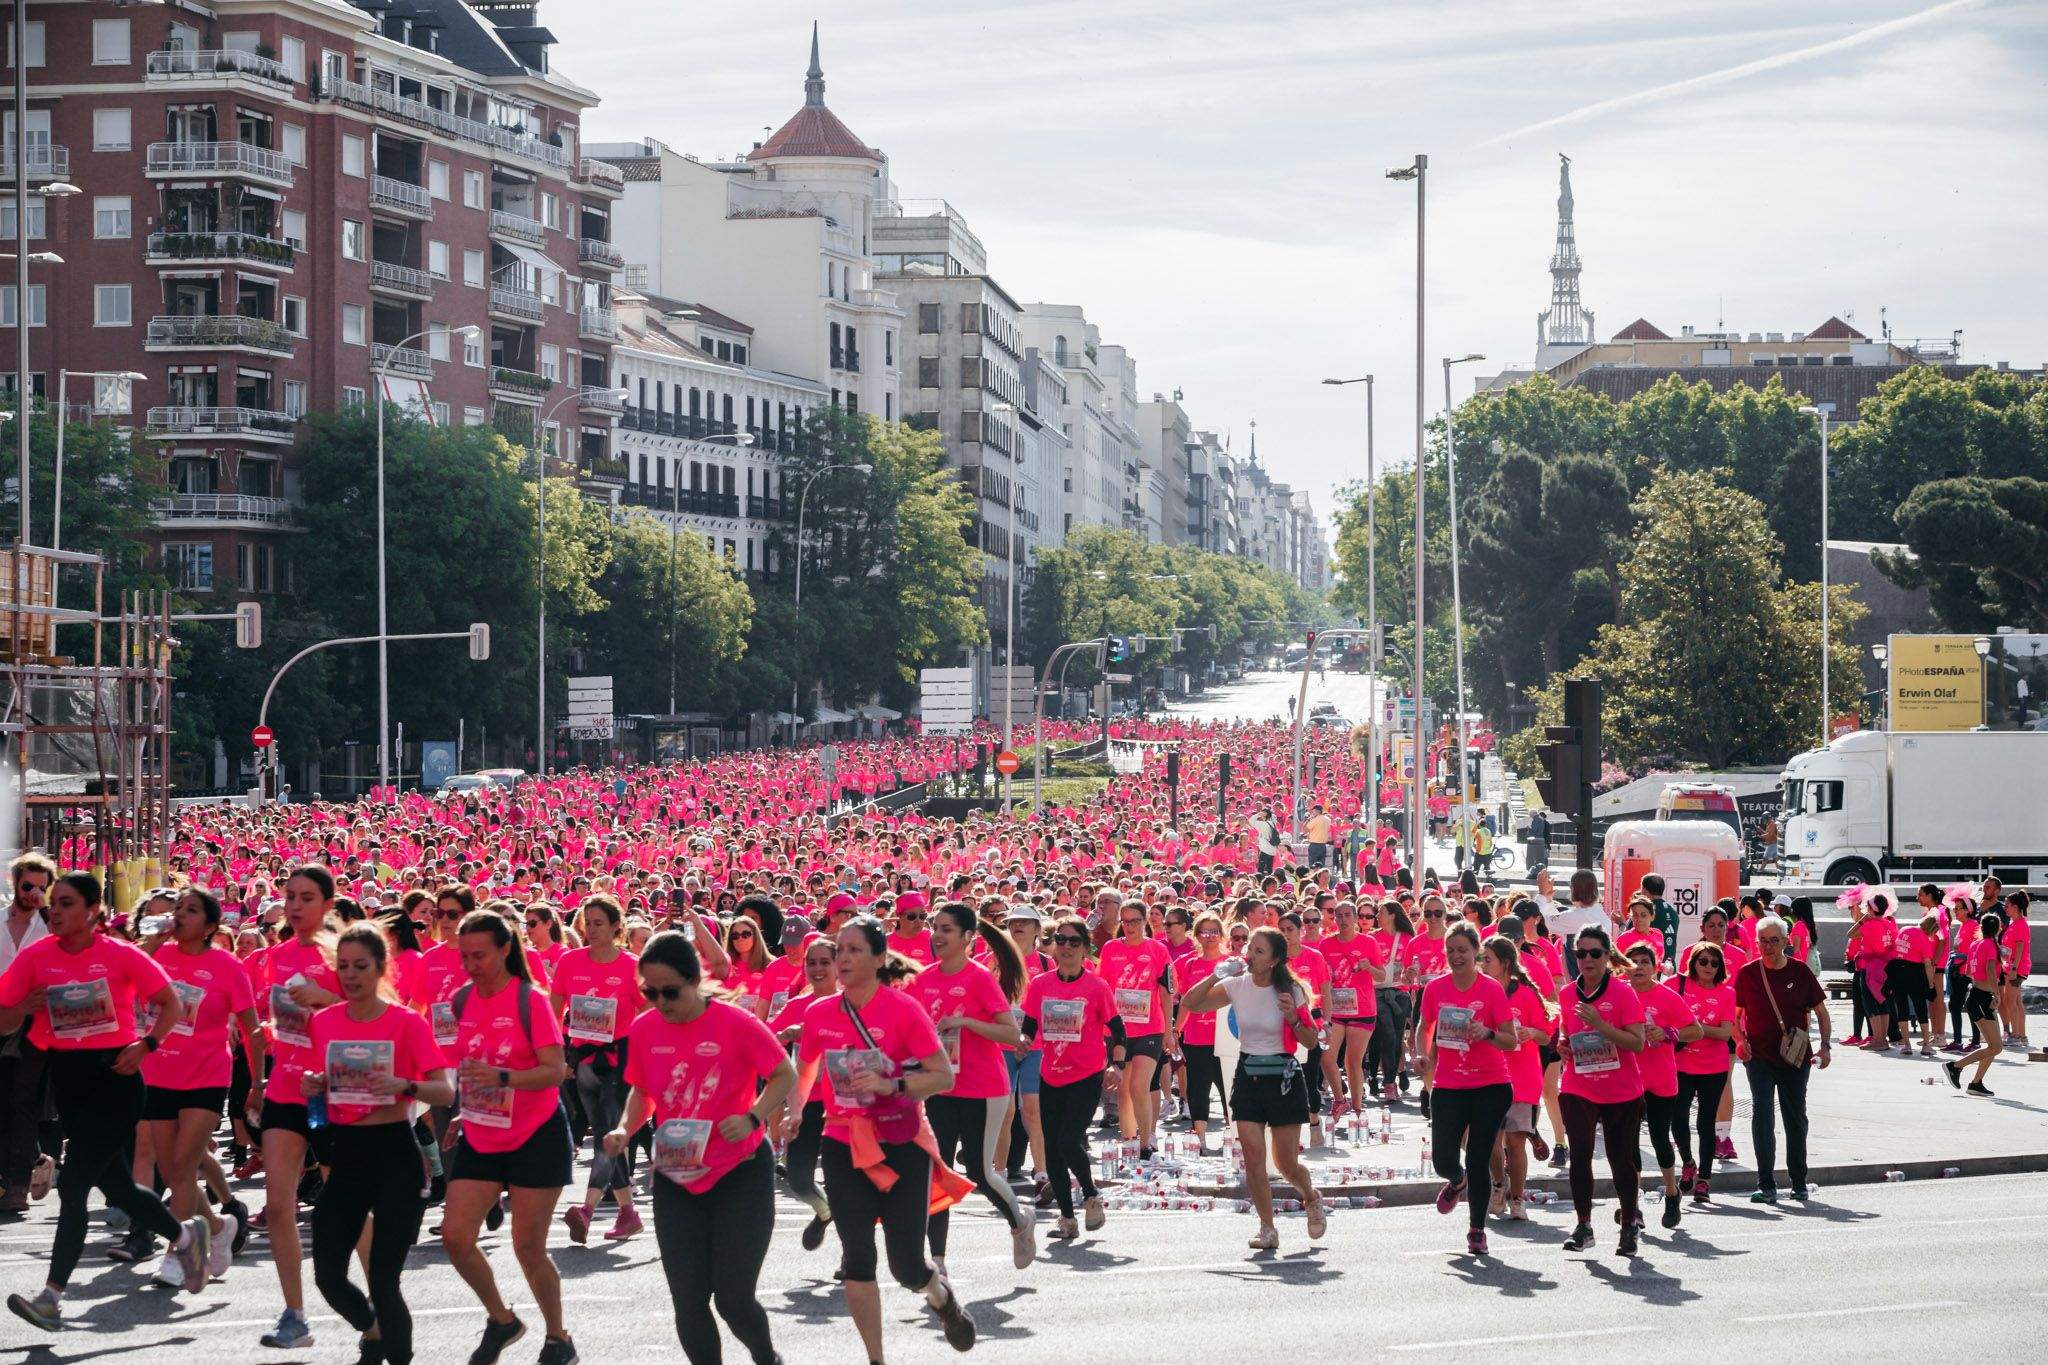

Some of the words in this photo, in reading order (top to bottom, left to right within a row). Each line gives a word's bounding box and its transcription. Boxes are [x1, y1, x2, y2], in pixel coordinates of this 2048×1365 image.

[1899, 665, 1965, 676] PHotoESPAÑA
[1899, 688, 1931, 698] Erwin
[1934, 688, 1957, 698] Olaf
[1742, 802, 1784, 811] TEATRO
[1673, 888, 1699, 902] TOI
[1673, 902, 1699, 916] TOI
